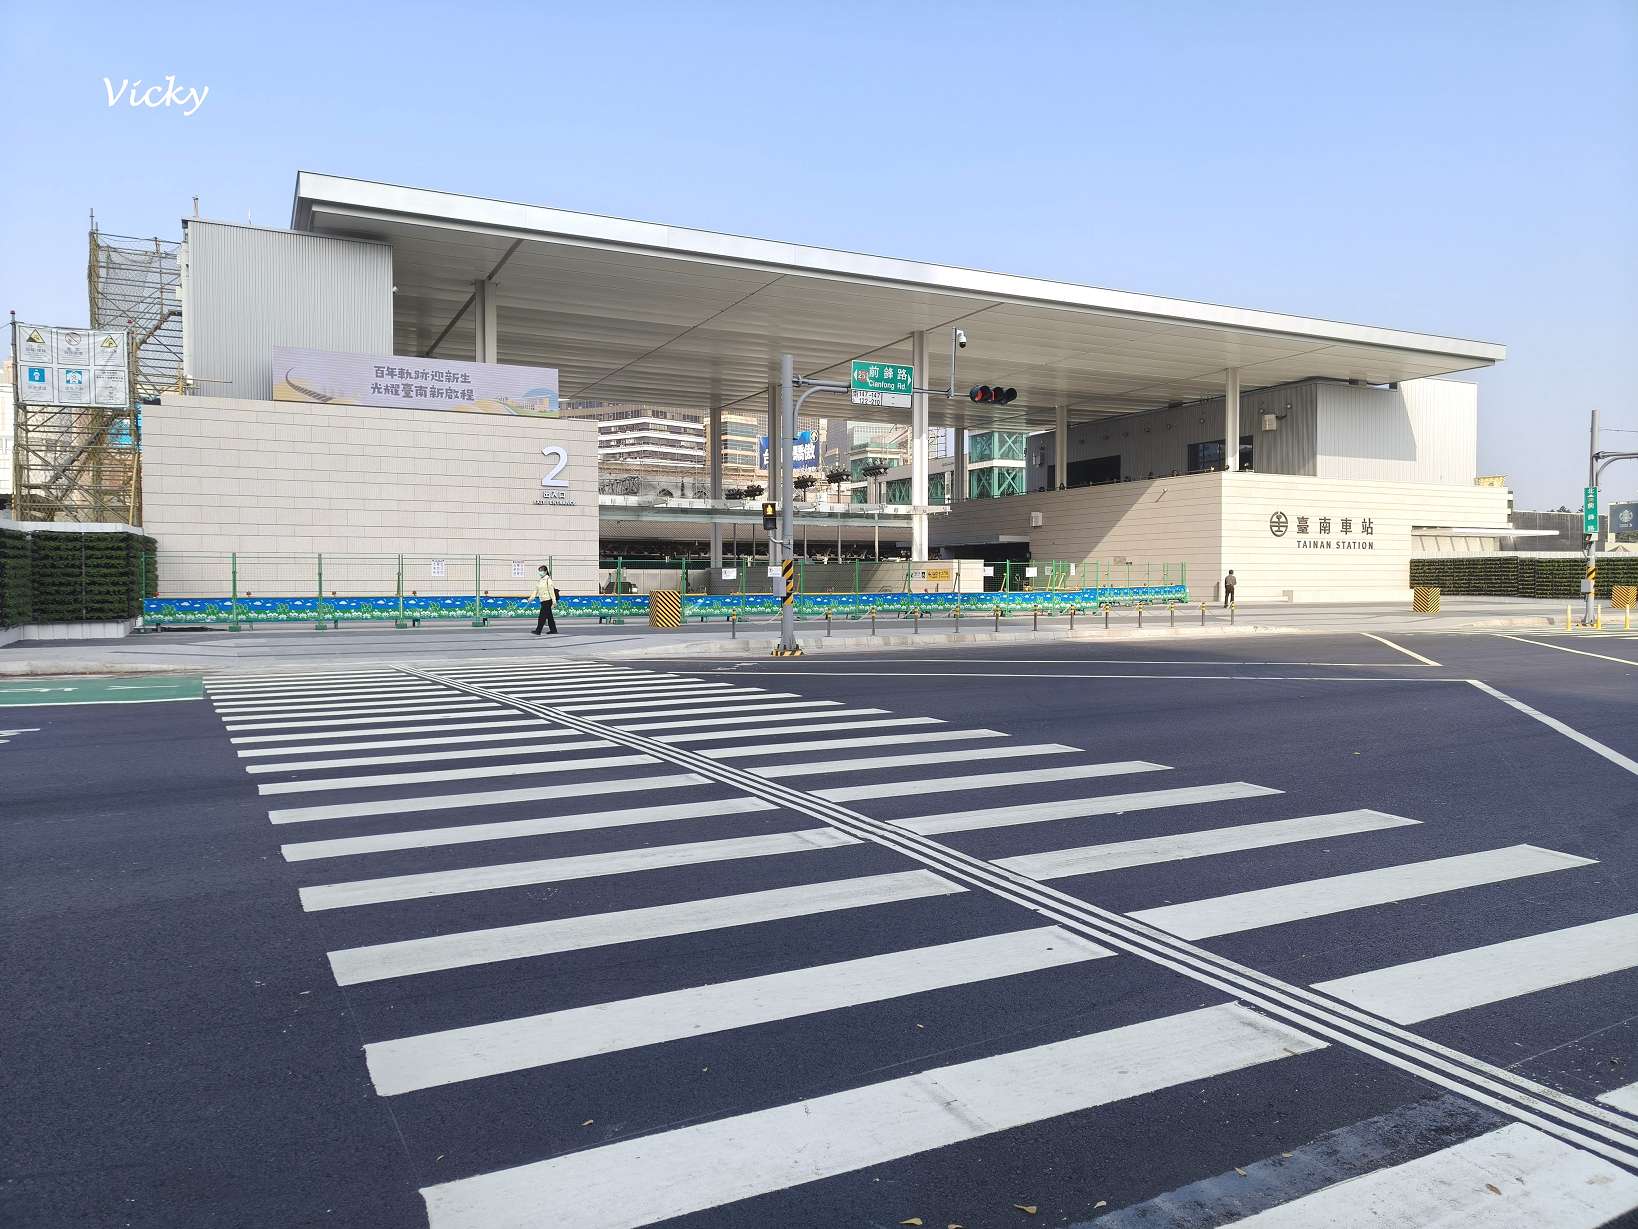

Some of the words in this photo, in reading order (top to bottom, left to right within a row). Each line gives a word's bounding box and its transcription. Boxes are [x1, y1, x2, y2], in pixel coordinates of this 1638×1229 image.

[373, 365, 471, 384] 百年軌跡迎新生
[869, 365, 908, 381] 前鋒路
[541, 446, 569, 488] 2
[1296, 516, 1374, 536] 臺南車站
[1296, 540, 1332, 550] TAINAN
[1335, 541, 1374, 550] STATION
